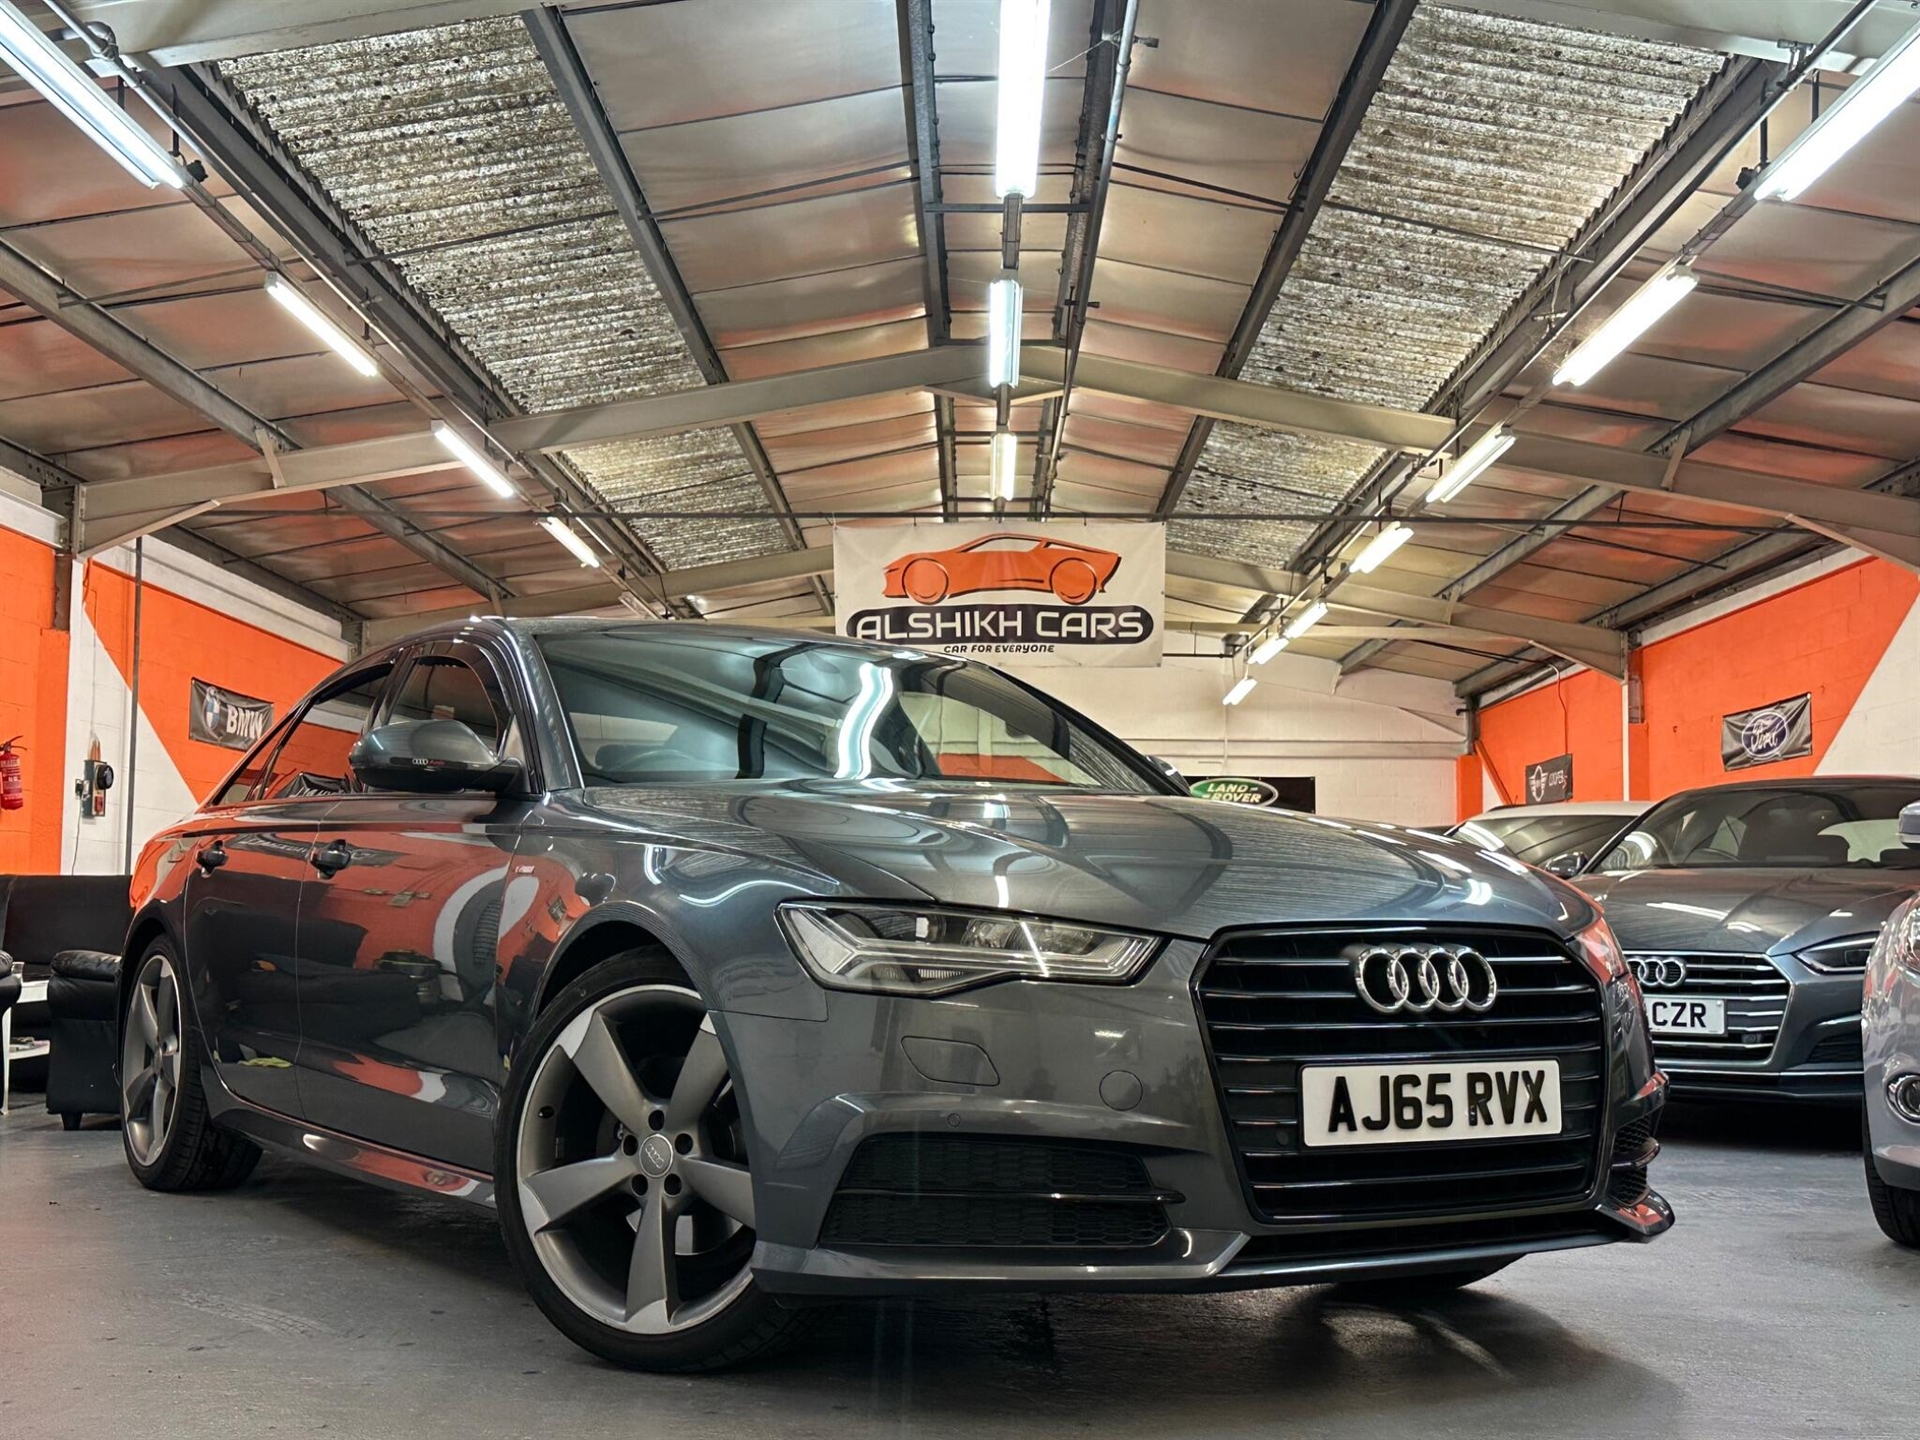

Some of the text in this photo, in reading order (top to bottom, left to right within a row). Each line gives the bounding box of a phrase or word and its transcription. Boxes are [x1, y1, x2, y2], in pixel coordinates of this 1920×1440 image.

[856, 610, 1144, 640] ALSHIKH CARS
[944, 645, 968, 653] CAR
[971, 644, 993, 653] FOR
[226, 704, 263, 741] BMW
[1207, 783, 1249, 793] LAND
[1211, 793, 1262, 803] ROVER
[1652, 1001, 1707, 1028] CZR
[1328, 1070, 1548, 1133] AJ65 RVX
